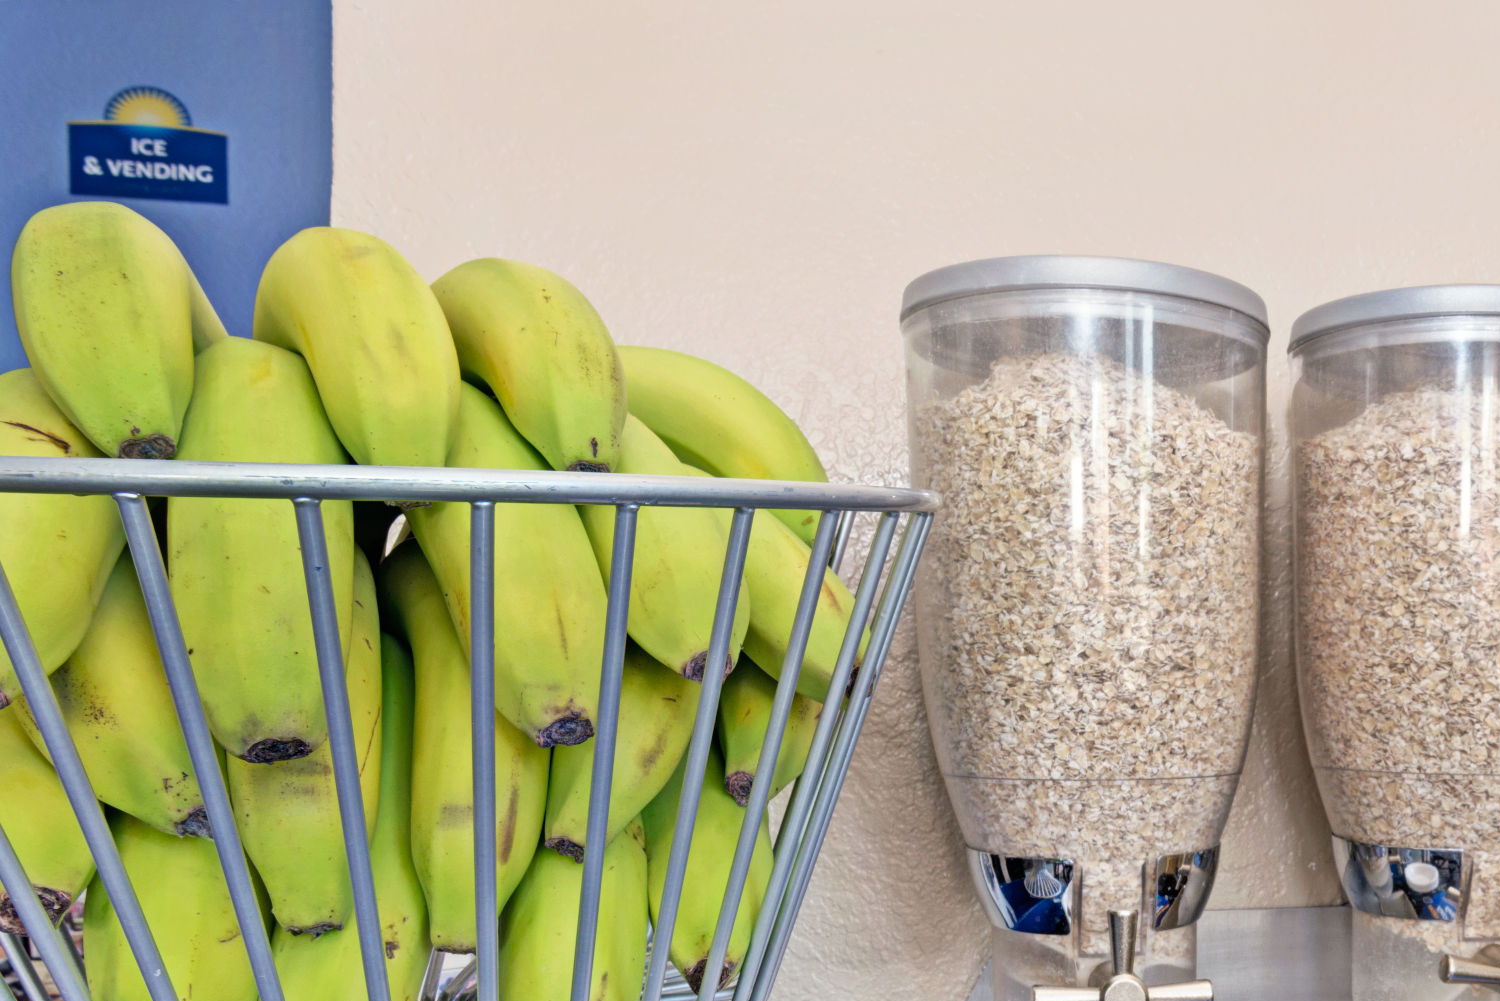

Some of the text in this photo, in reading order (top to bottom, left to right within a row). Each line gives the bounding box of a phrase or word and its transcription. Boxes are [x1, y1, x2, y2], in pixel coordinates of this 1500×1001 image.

[131, 137, 168, 157] ICE
[83, 155, 213, 183] & VENDING
